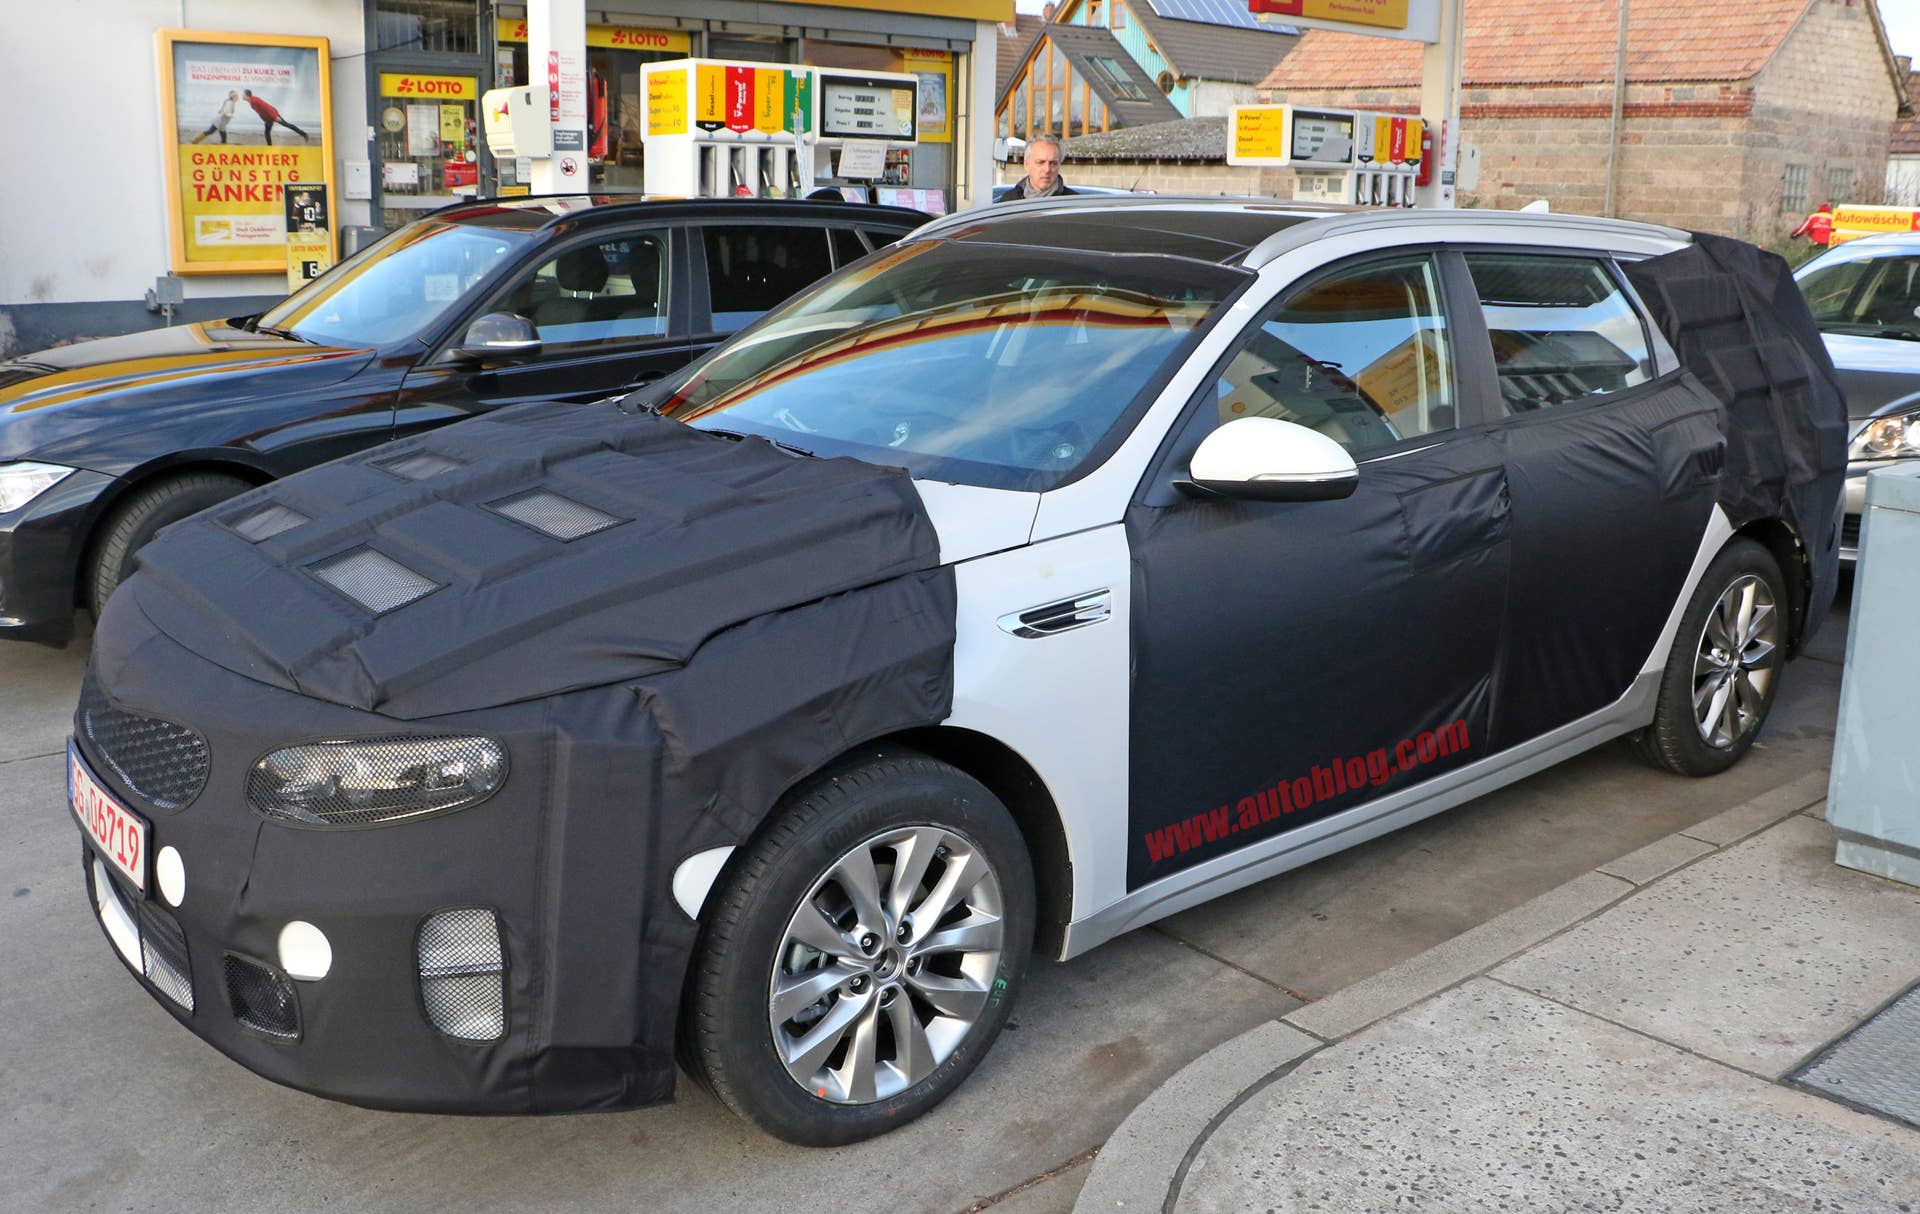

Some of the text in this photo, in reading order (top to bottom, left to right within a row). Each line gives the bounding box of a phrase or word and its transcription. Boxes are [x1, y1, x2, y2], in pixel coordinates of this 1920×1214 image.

[629, 33, 669, 47] LOTTO
[417, 80, 463, 95] LOTTO
[191, 152, 299, 167] GARANTIERT
[192, 167, 300, 182] GÜNSTIG
[303, 206, 316, 222] 10
[1834, 211, 1910, 226] Autowäsche
[309, 262, 318, 277] 6
